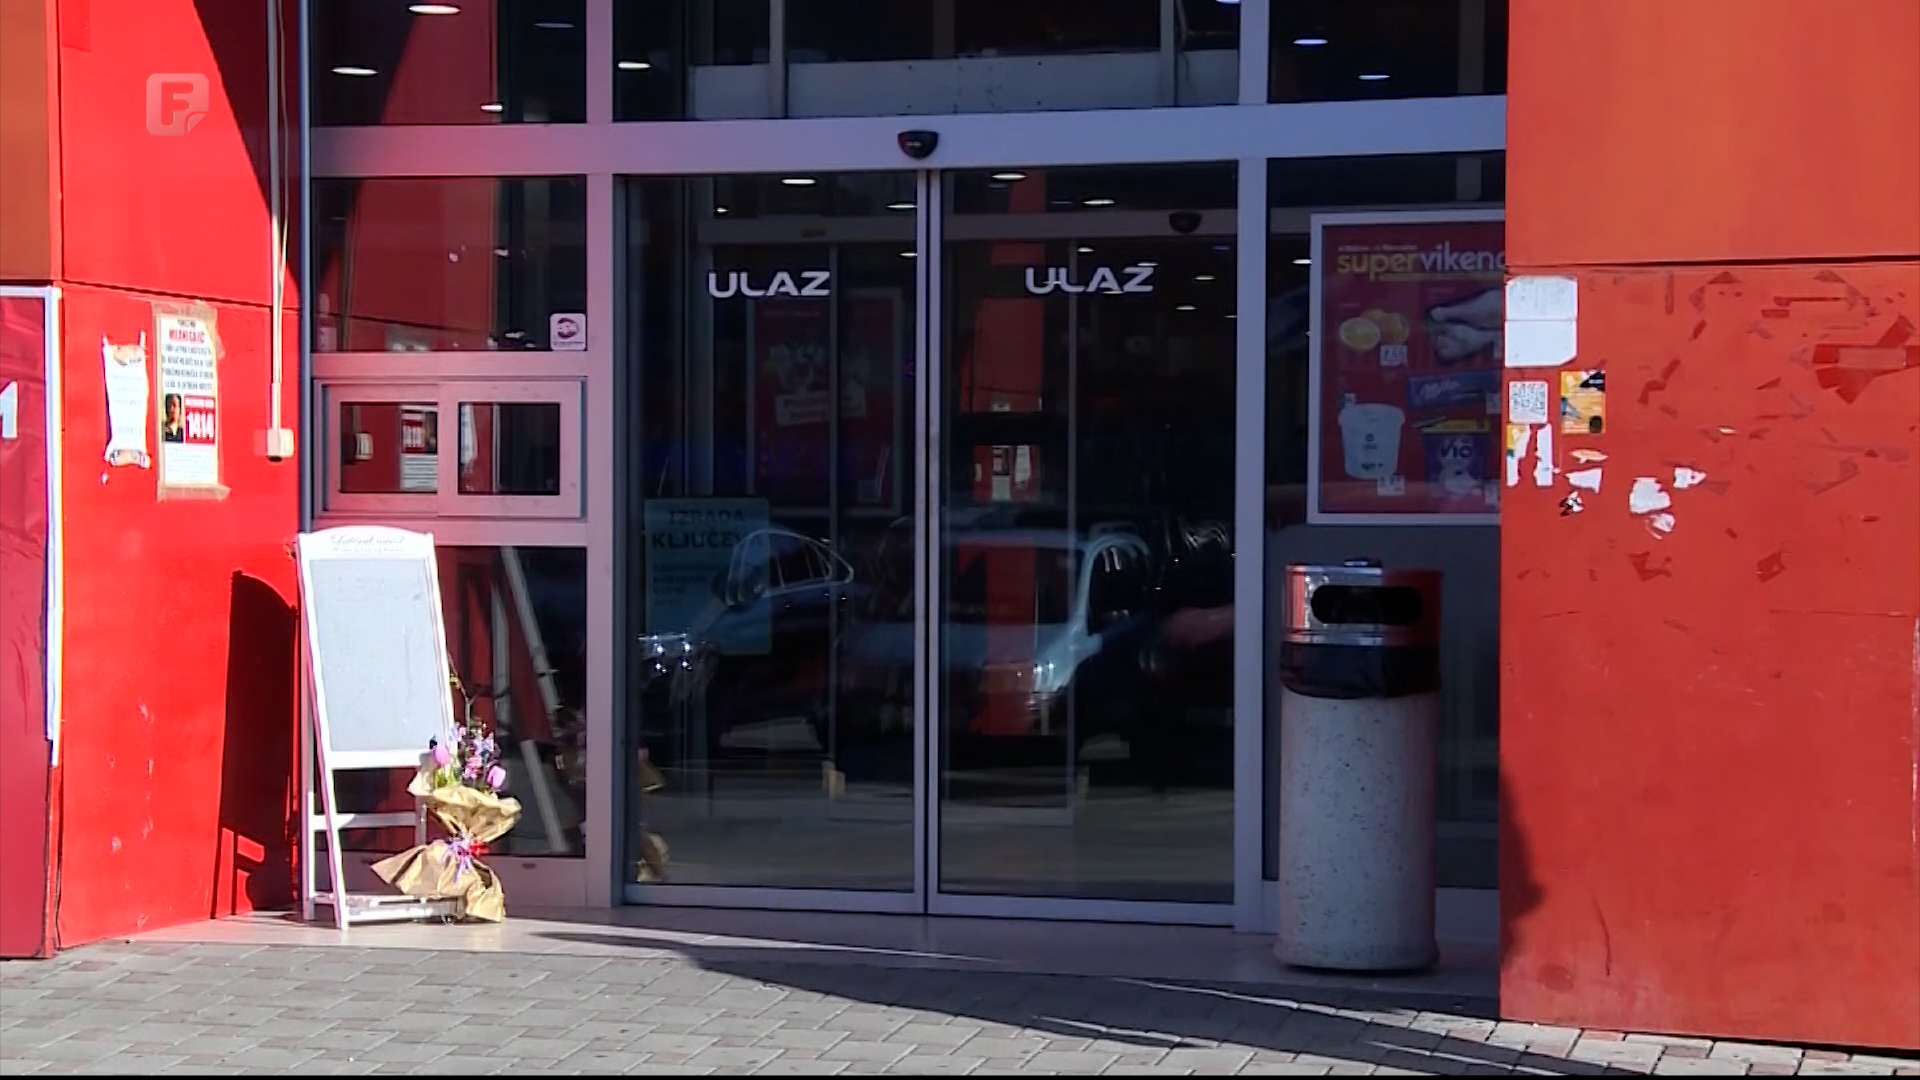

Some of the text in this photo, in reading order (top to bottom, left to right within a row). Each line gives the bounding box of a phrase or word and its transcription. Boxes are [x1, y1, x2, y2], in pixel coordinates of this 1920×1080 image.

[708, 270, 832, 299] ULAZ
[1024, 266, 1155, 295] ULAZ
[187, 411, 216, 439] 1414
[669, 508, 744, 526] IZRADA
